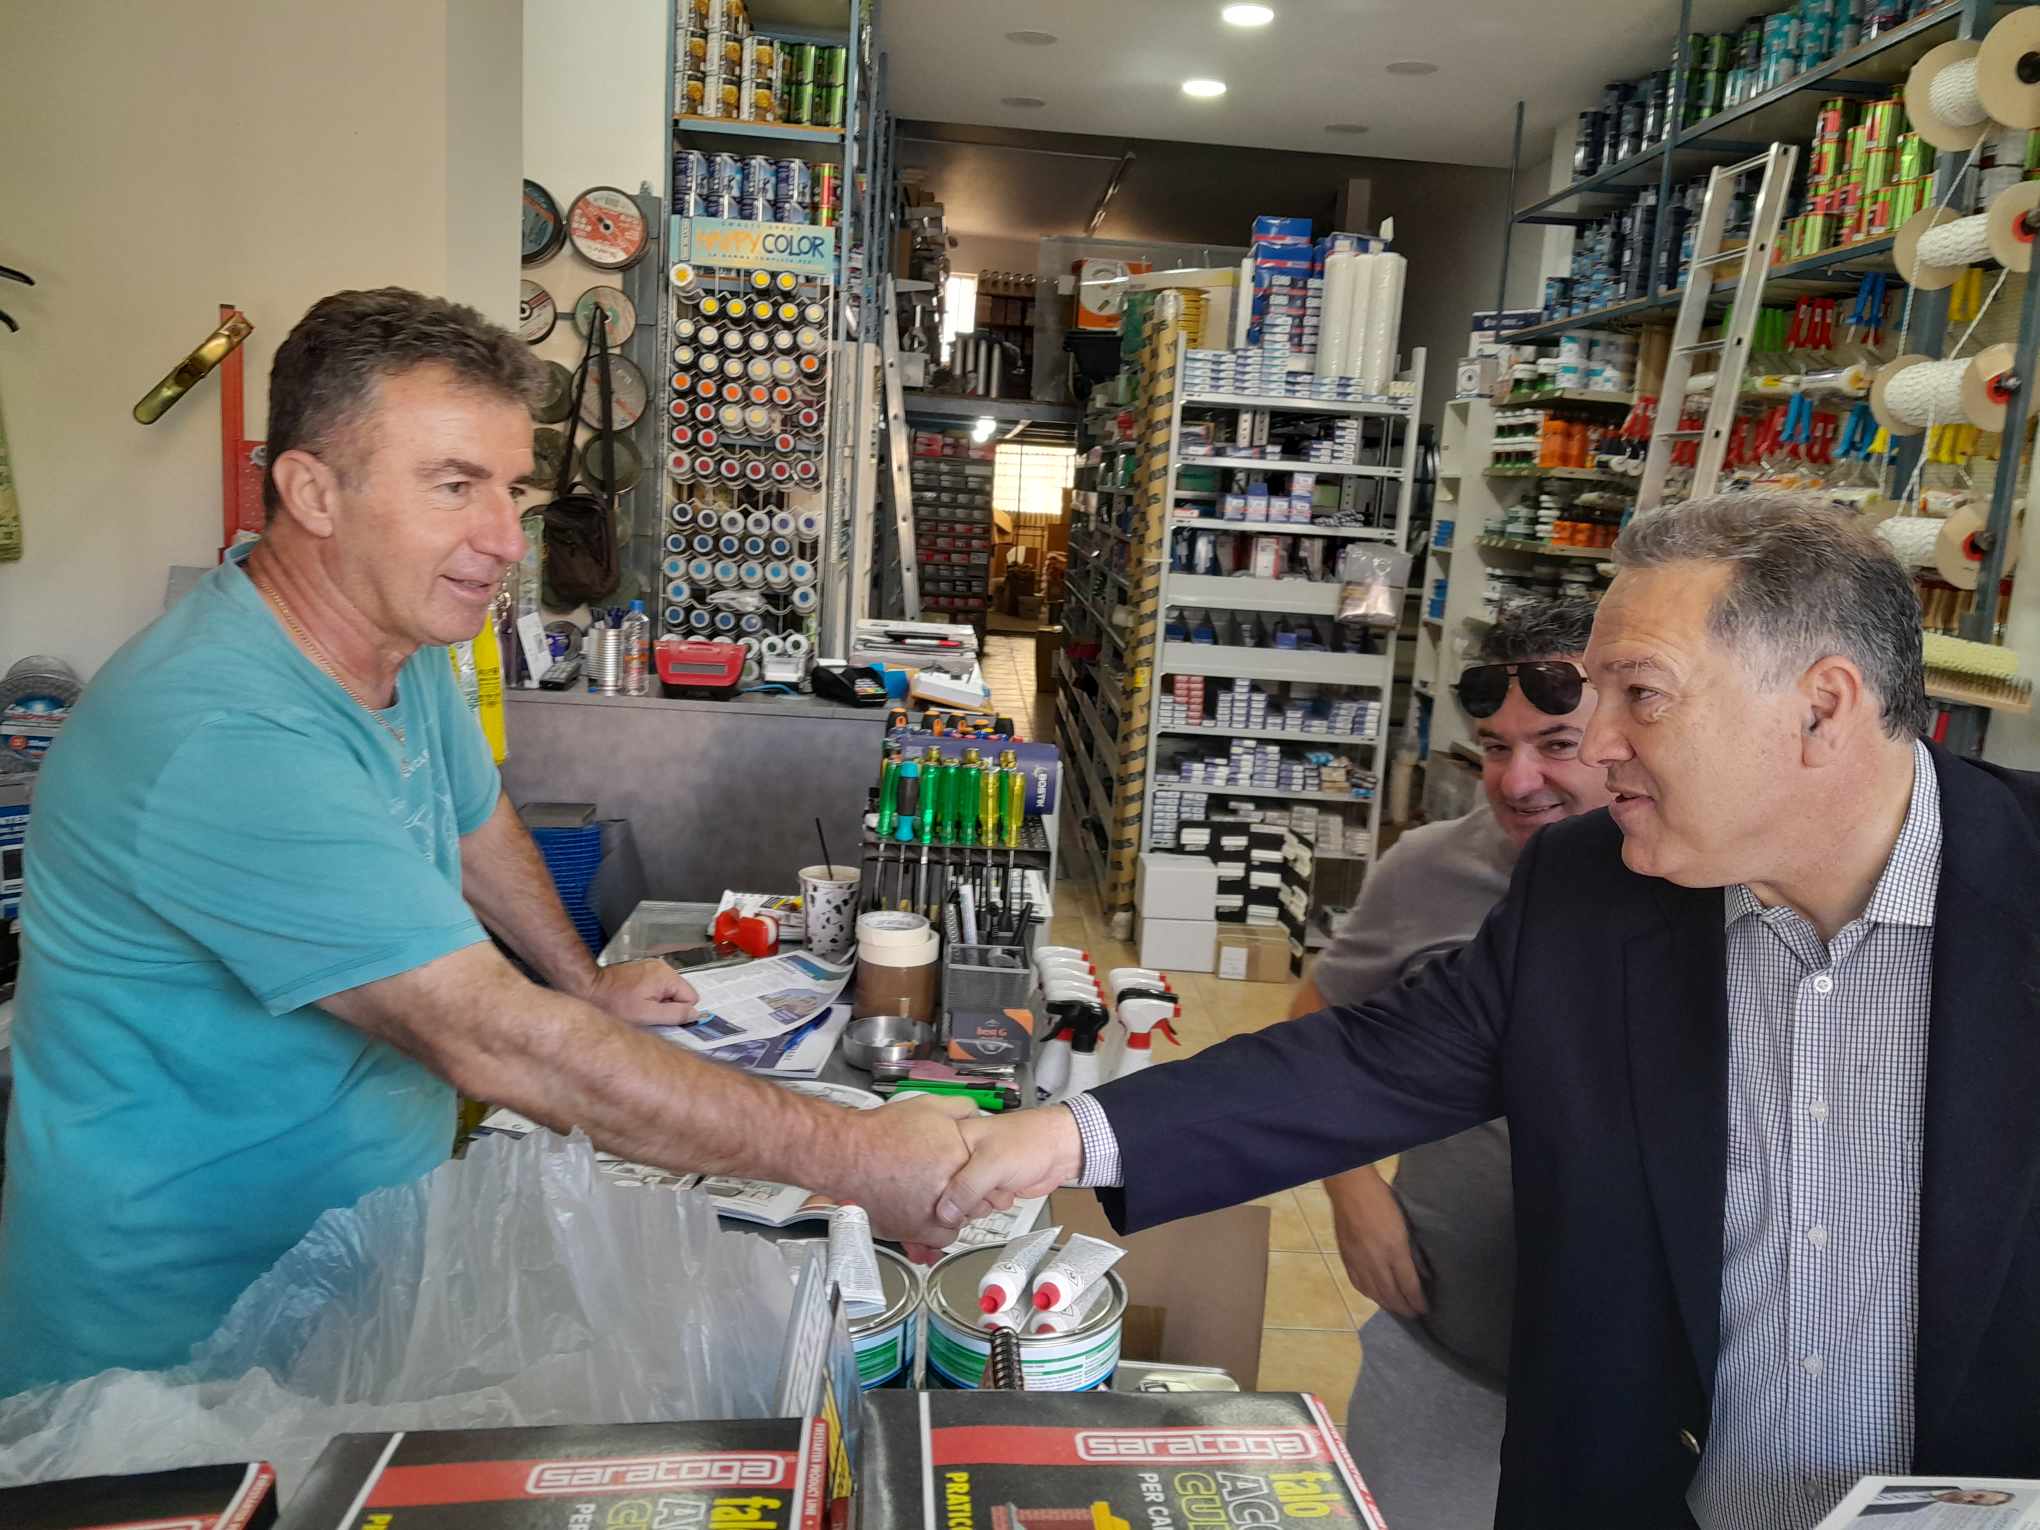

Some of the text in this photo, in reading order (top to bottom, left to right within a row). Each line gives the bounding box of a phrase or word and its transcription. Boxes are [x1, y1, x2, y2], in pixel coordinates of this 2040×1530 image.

[762, 233, 825, 258] COLOR
[1087, 1435, 1303, 1461] saratoga
[541, 1459, 772, 1487] saratoga
[1137, 1473, 1166, 1502] PER
[708, 1495, 782, 1530] fal
